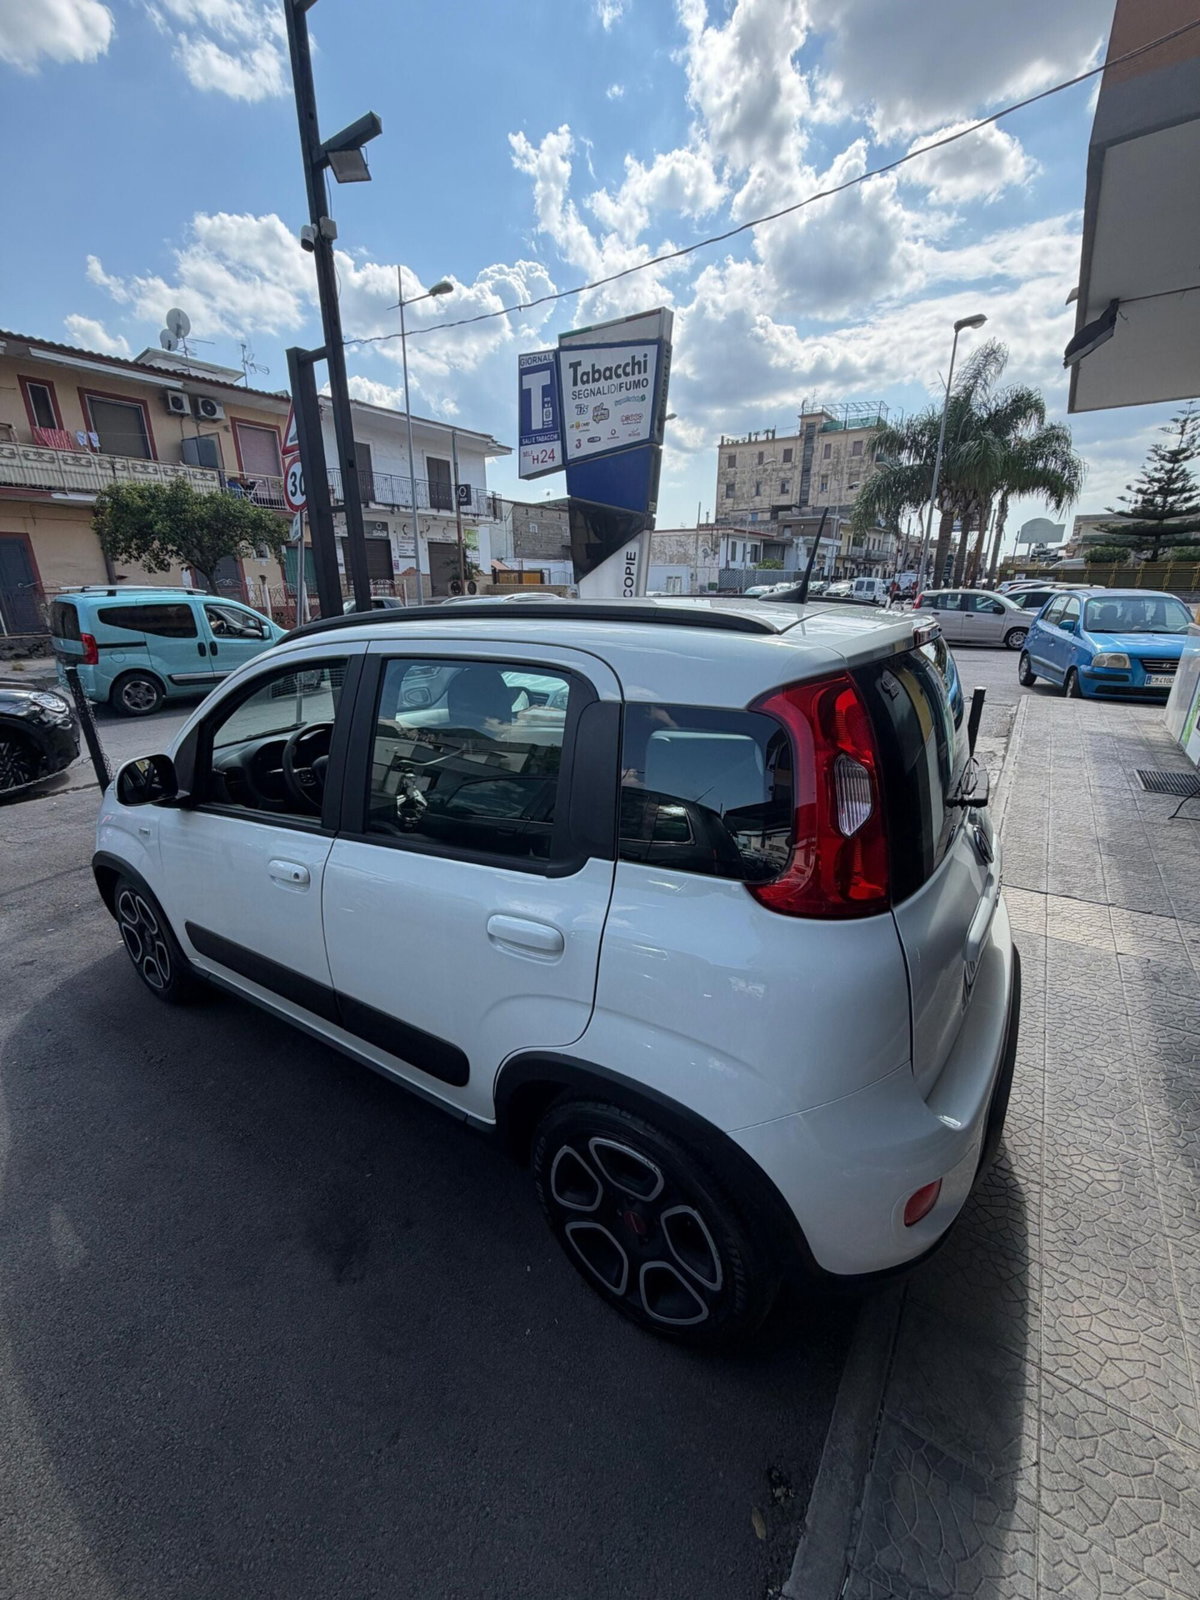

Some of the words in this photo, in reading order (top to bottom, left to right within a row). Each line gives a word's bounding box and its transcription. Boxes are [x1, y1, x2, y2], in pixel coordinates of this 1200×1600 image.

[568, 353, 648, 387] Tabacchi
[521, 369, 551, 430] T
[623, 551, 637, 597] COPIE
